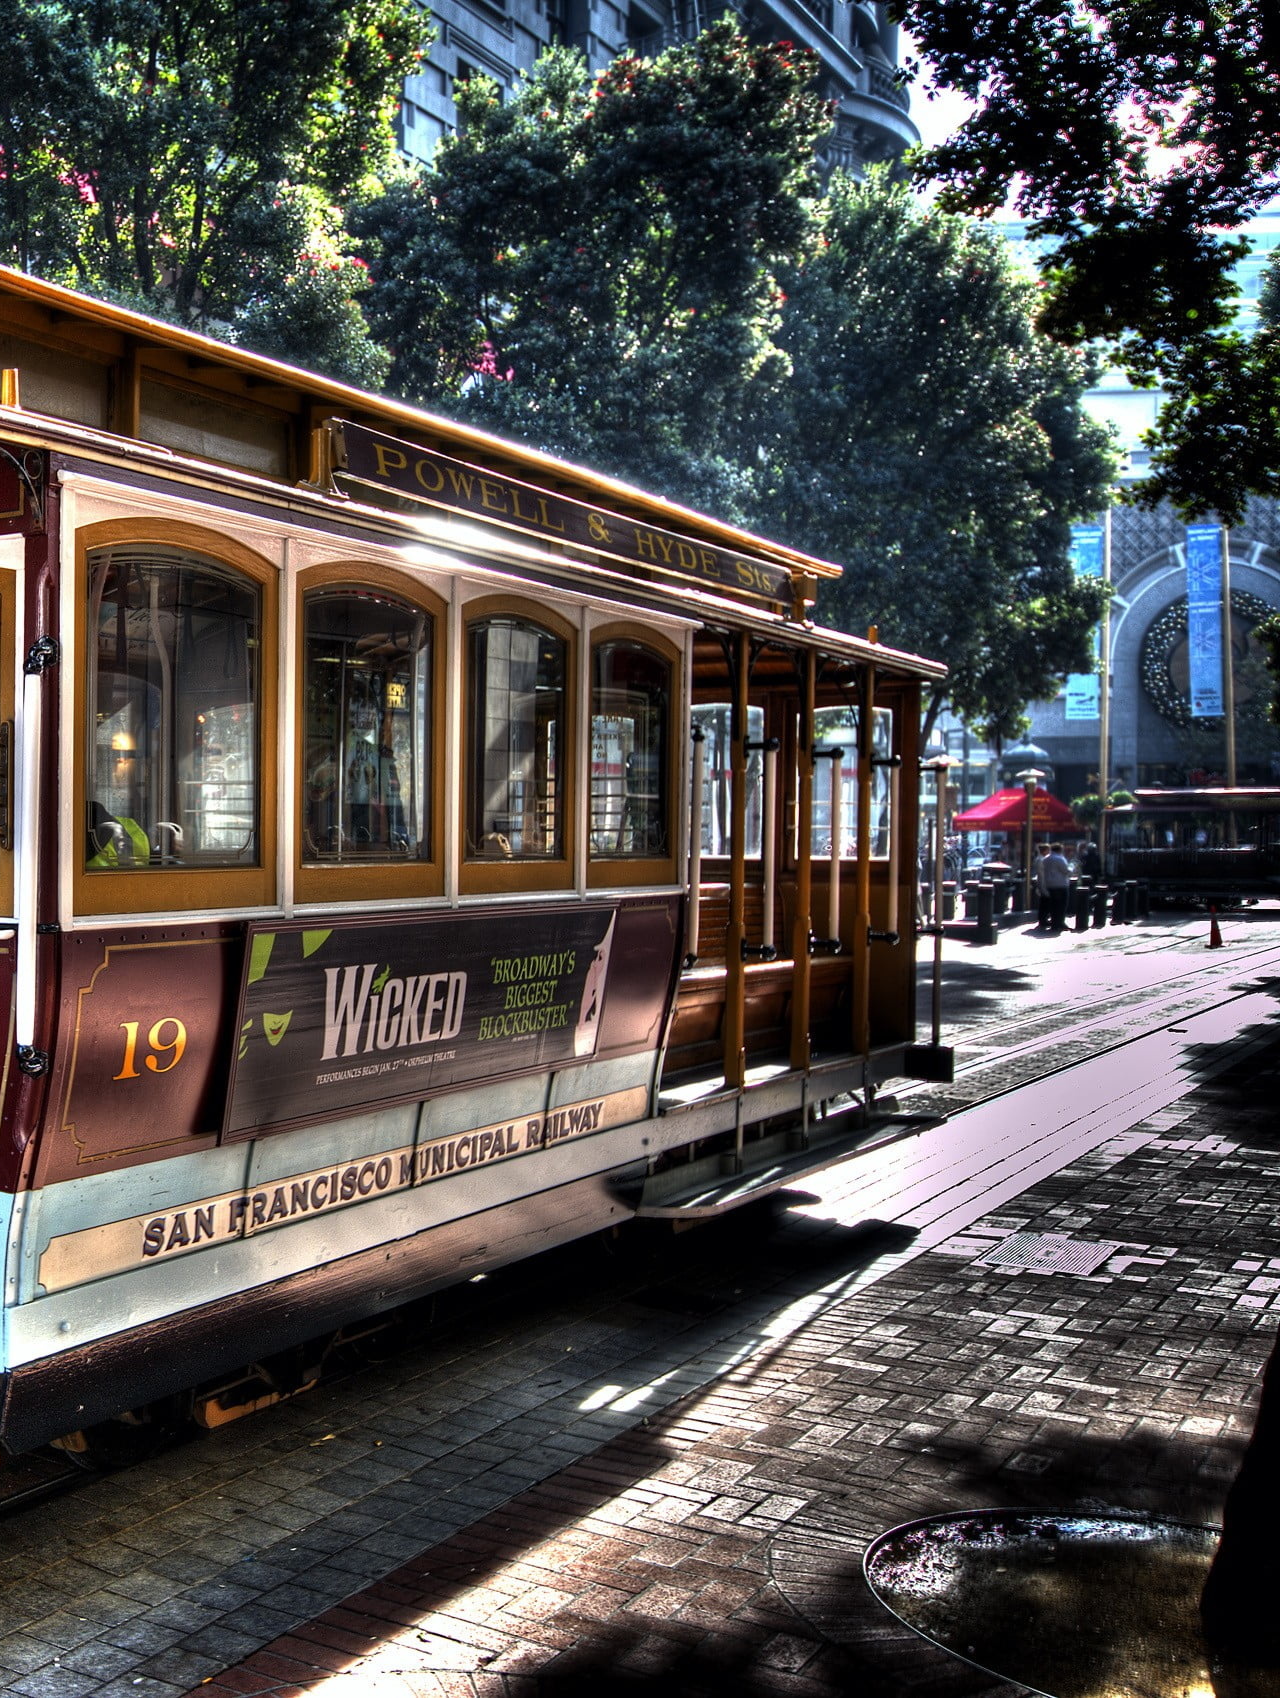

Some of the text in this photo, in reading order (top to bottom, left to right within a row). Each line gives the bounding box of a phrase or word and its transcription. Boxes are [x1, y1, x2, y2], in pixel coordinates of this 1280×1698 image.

[372, 442, 777, 594] POWELL & HYDE Sts.
[490, 949, 576, 984] "BROADWAY'S
[504, 980, 558, 1010] BIGGEST
[112, 1017, 187, 1080] 19
[316, 1067, 361, 1085] PERFORMANCES
[361, 1063, 380, 1076] BEGIN
[433, 1050, 457, 1062] THEATRE
[143, 1101, 604, 1257] SAN FRANCISCO MUNICIPAL RAILWAY
